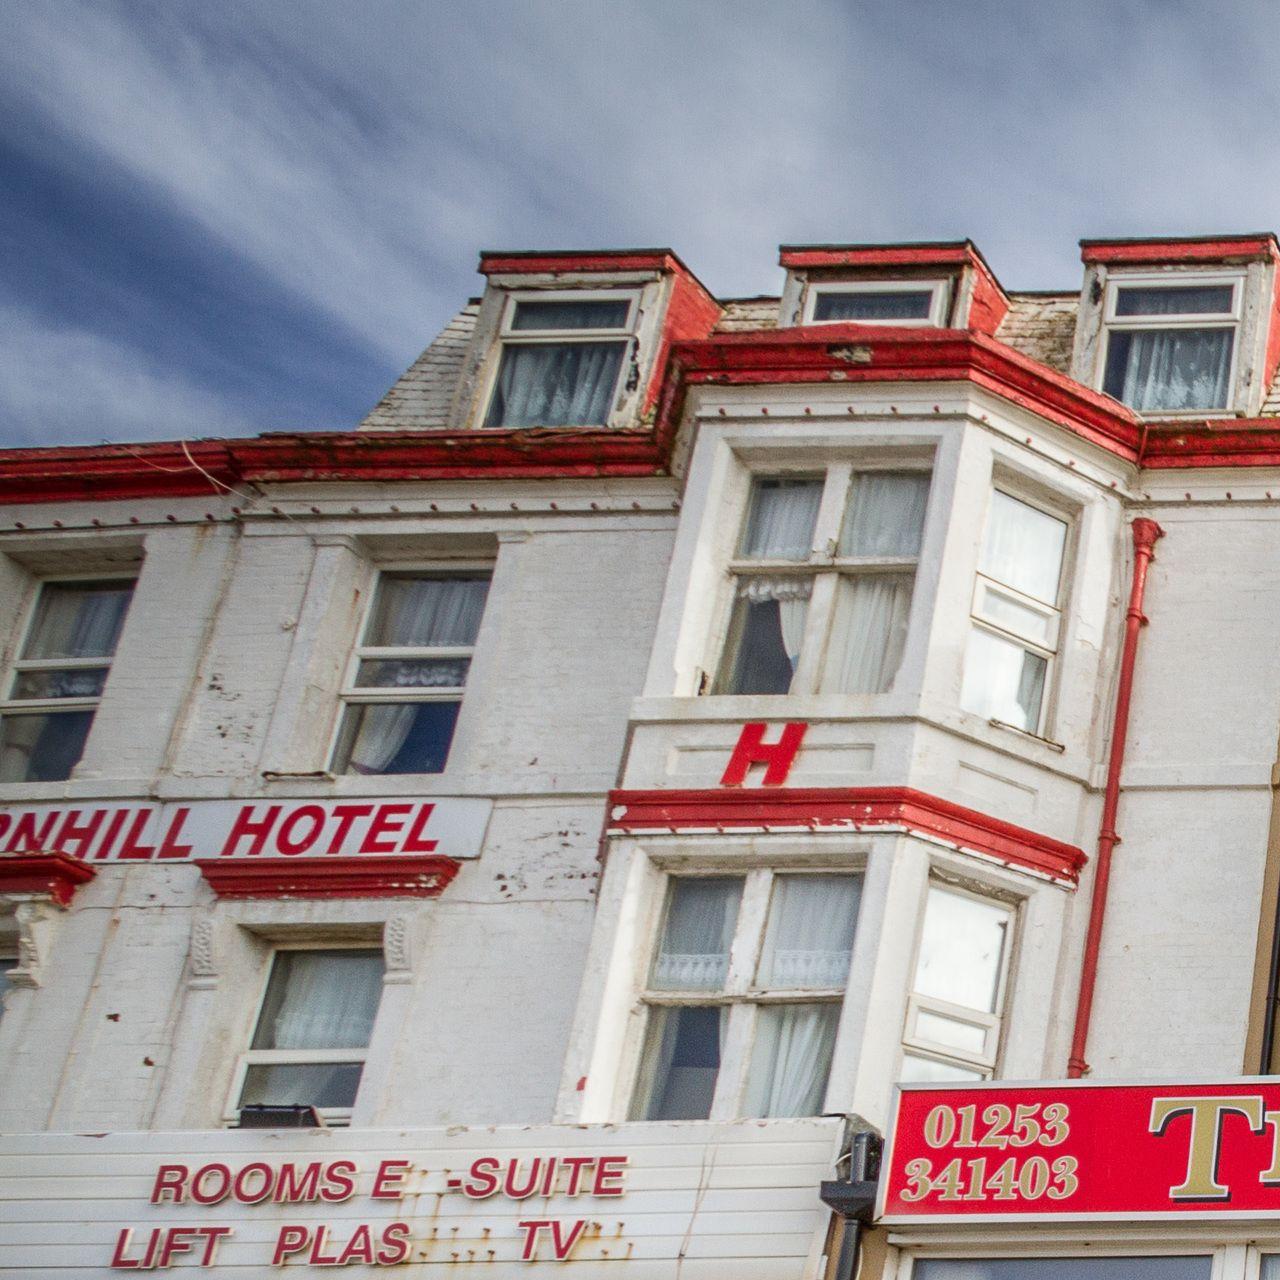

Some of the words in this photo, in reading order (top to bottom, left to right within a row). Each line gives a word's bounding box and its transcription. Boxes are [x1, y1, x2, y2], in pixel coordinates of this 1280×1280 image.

[721, 722, 808, 787] H
[221, 803, 441, 857] HOTEL
[923, 1102, 1072, 1149] 01253
[150, 1159, 358, 1205] ROOMS
[899, 1155, 1080, 1202] 341403
[110, 1226, 233, 1270] LIFT
[518, 1218, 590, 1262] TV
